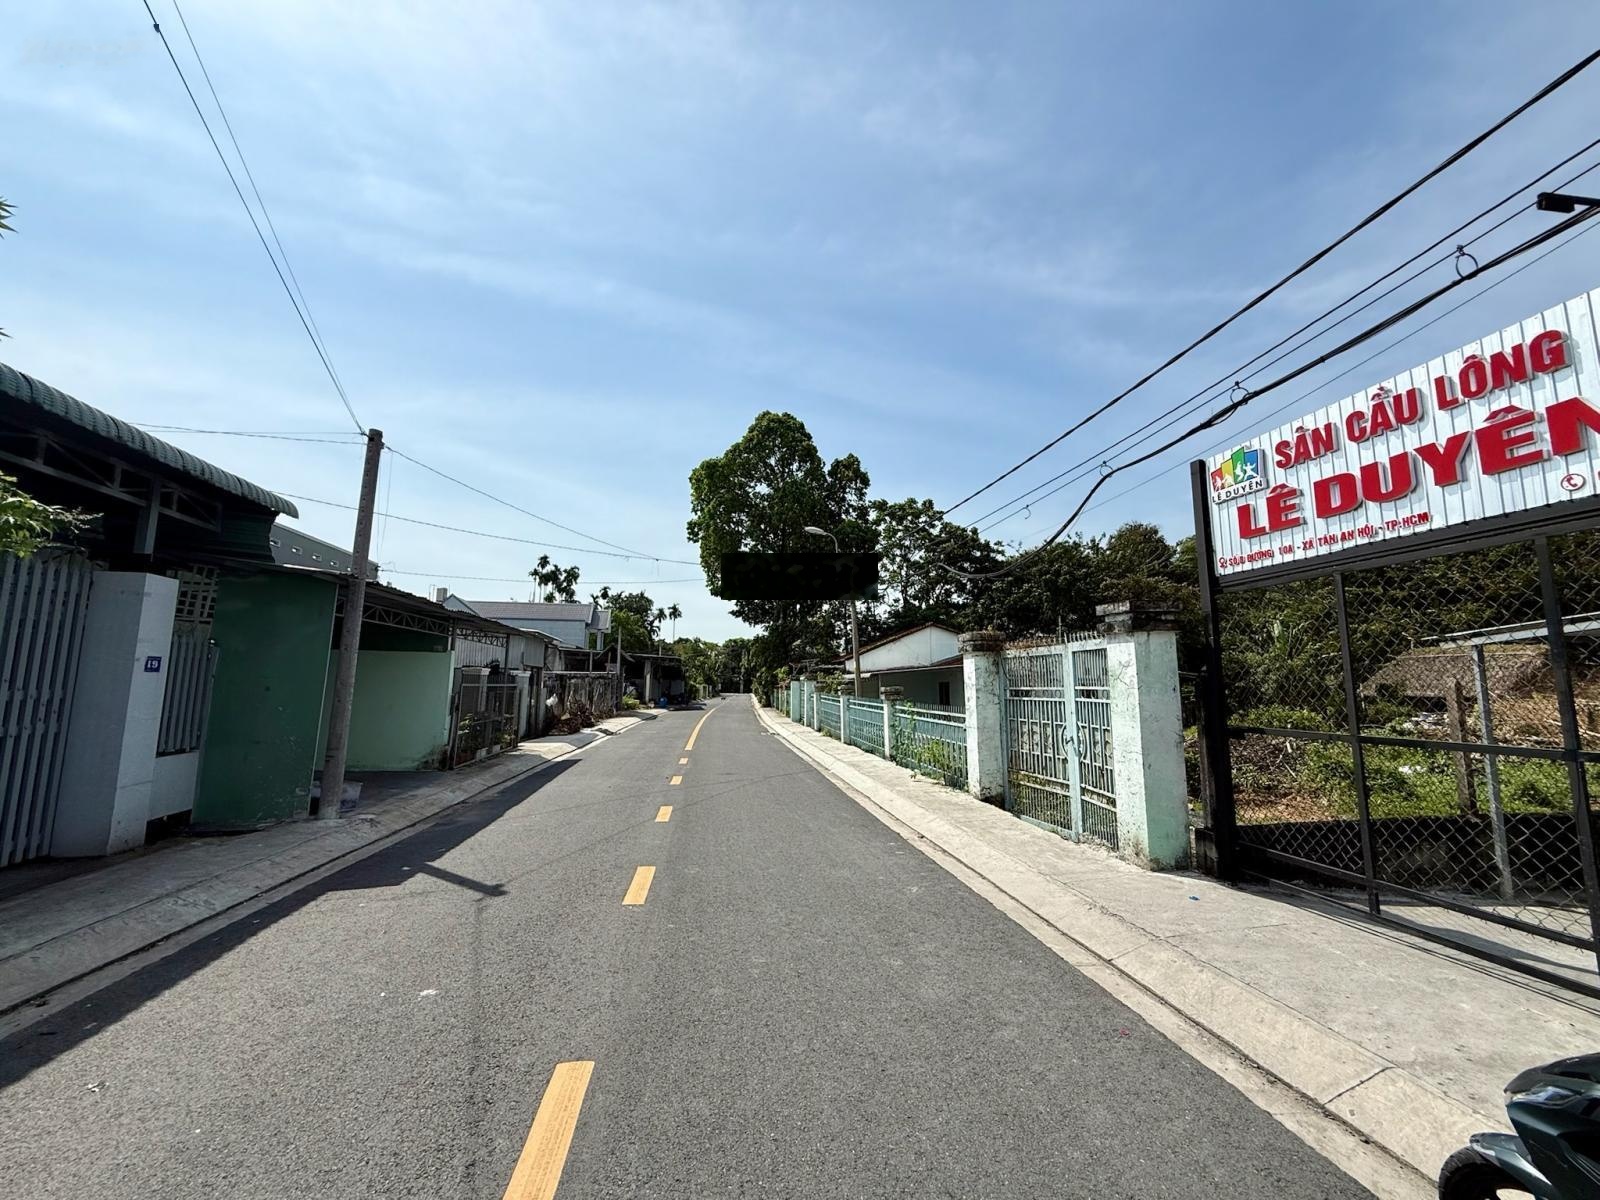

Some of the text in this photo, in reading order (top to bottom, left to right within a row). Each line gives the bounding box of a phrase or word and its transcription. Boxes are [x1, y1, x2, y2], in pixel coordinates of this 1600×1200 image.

[1275, 330, 1568, 469] SÂN CẦU LÔNG
[1212, 480, 1263, 503] LÊ DUYÊN
[1237, 483, 1302, 539] LÊ
[1318, 533, 1336, 547] TÂN
[1340, 529, 1354, 542] AN
[147, 660, 159, 669] 19
